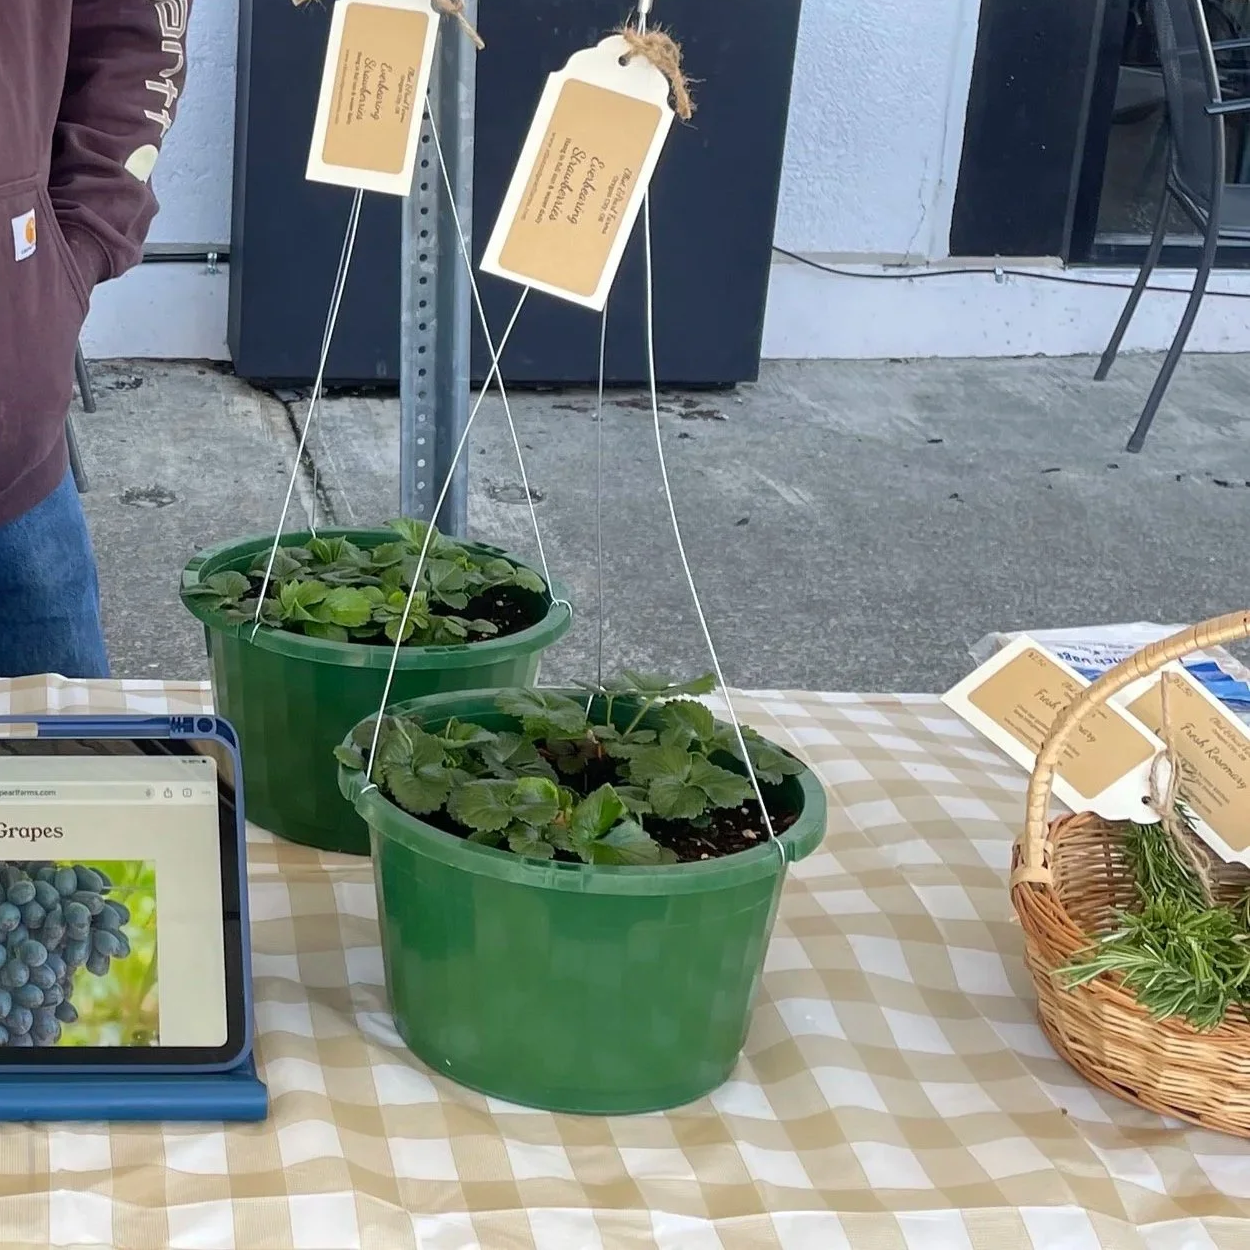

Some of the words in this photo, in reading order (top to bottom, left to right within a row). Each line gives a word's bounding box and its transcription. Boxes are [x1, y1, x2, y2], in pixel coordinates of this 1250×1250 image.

[548, 146, 587, 221] Strawberries
[566, 156, 605, 225] Everbearing
[1180, 722, 1211, 748] Fresh
[1204, 746, 1247, 790] Rosemary
